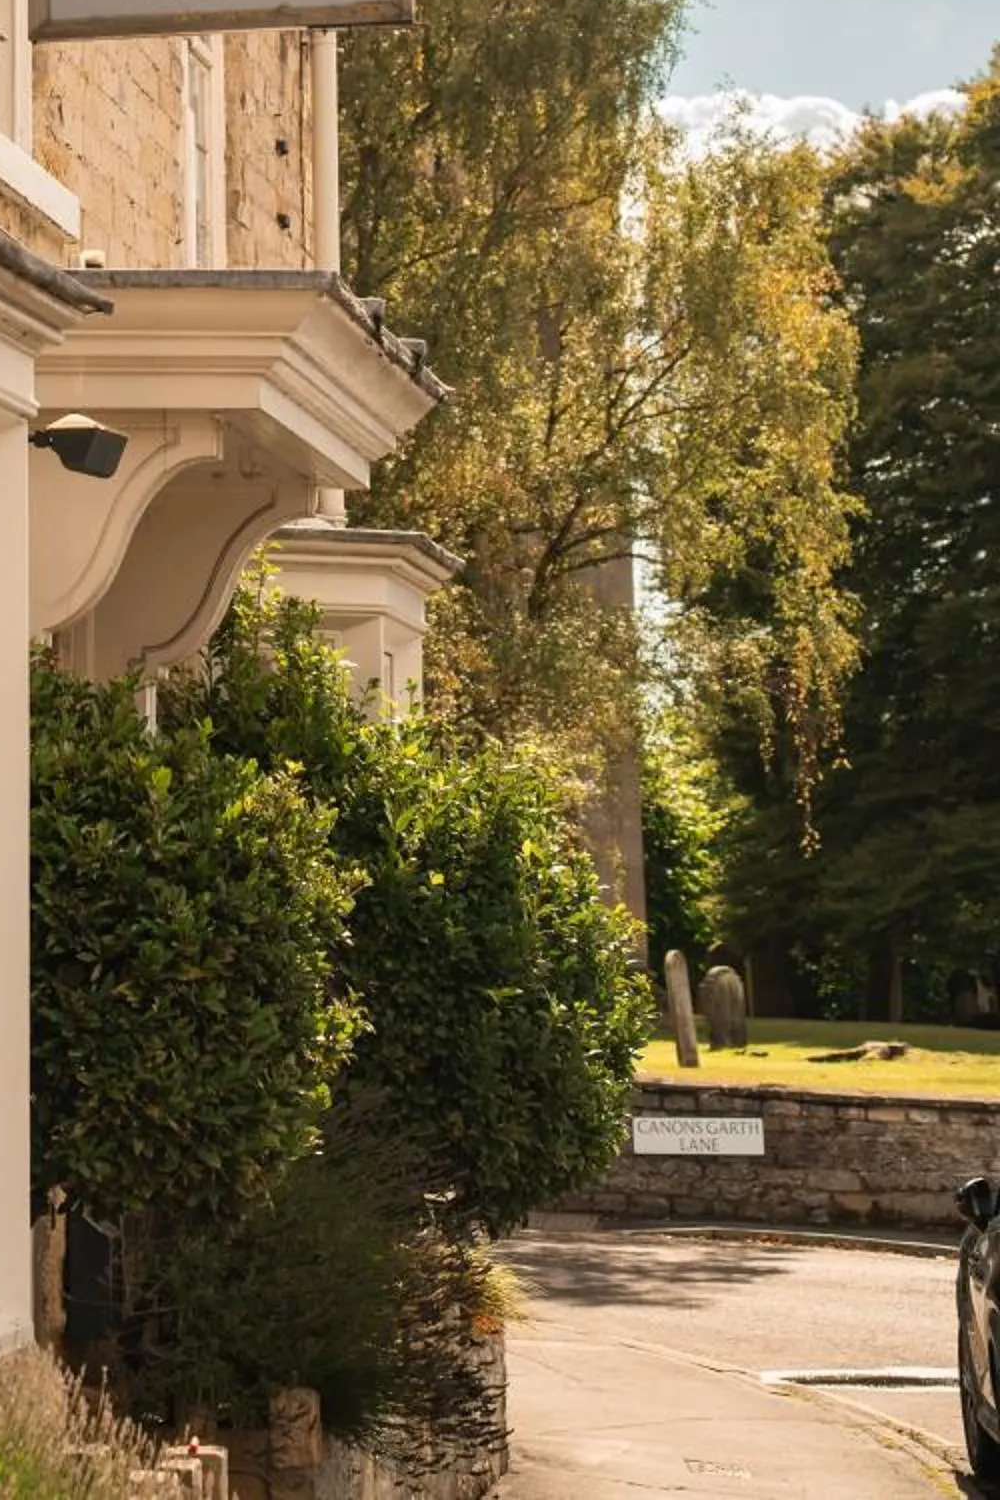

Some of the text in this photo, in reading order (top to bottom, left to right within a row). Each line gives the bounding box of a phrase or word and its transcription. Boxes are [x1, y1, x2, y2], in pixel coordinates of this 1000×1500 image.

[637, 1119, 761, 1136] CANONS GARTH
[679, 1137, 721, 1153] LANE
